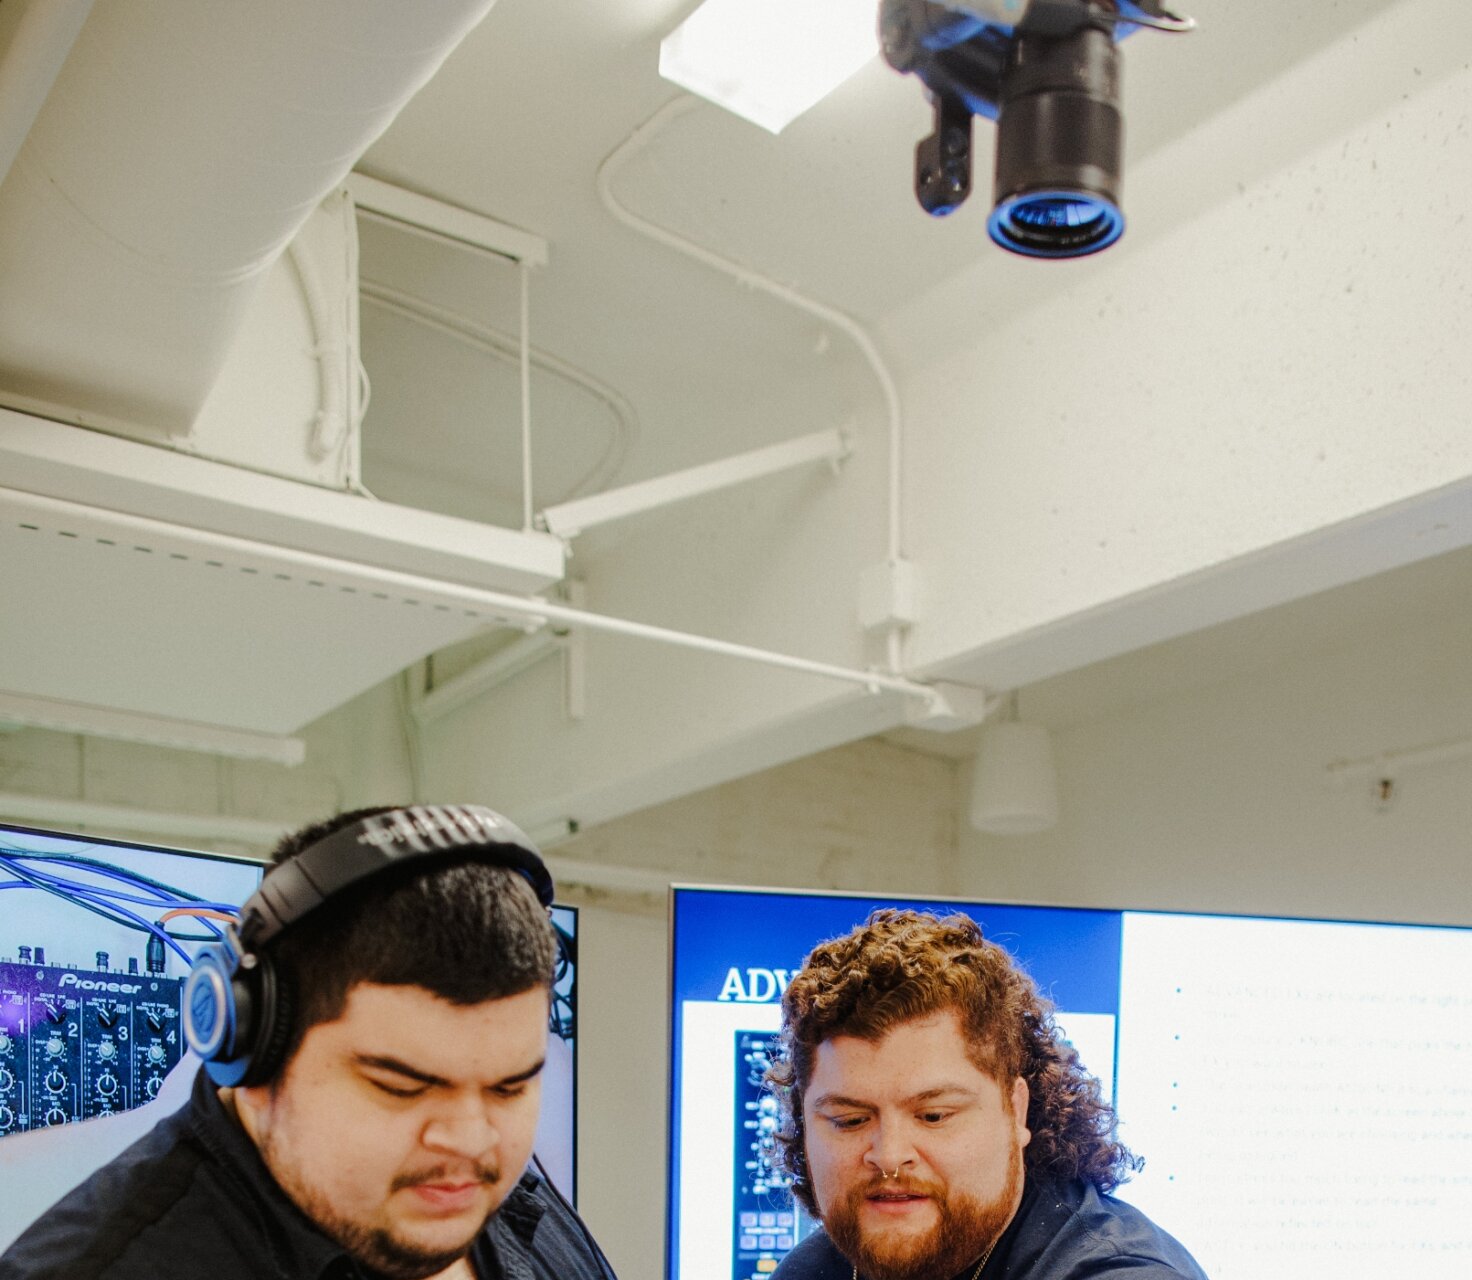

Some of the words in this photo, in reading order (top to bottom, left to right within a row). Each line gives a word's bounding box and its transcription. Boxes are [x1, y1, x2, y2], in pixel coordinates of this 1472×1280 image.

[58, 973, 142, 995] Pioneer
[18, 1018, 25, 1034] 1
[68, 1022, 79, 1037] 2
[118, 1026, 129, 1041] 3
[166, 1030, 177, 1045] 4
